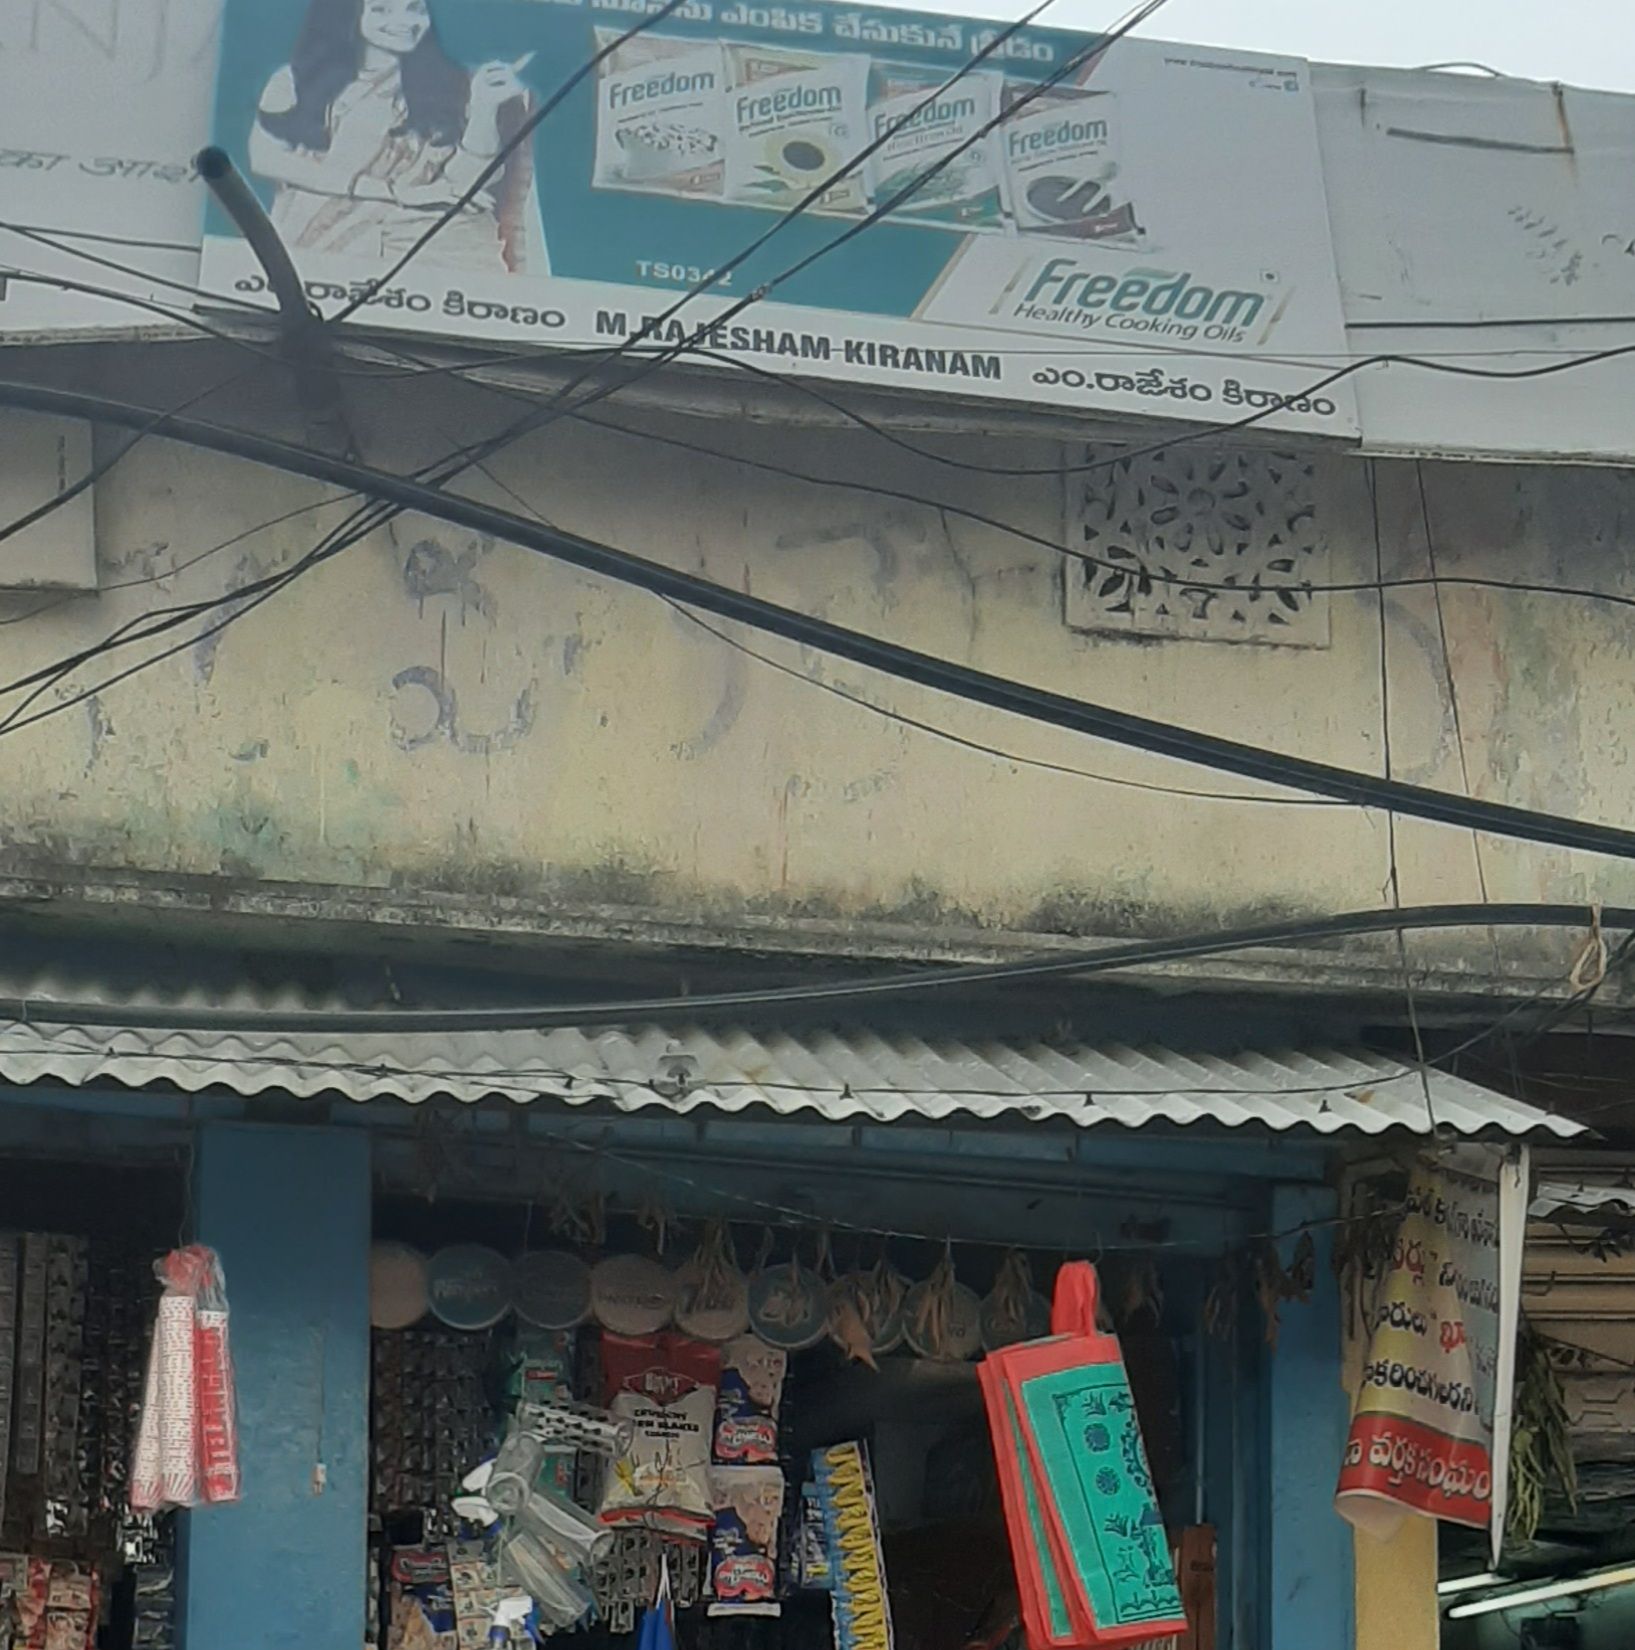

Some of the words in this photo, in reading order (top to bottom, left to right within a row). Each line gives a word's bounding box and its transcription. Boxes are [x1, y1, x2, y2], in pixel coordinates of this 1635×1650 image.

[609, 71, 715, 110] Freedom
[735, 84, 842, 124] Freedom
[874, 97, 975, 141] Freedom
[1008, 118, 1108, 158] Freedom
[1023, 257, 1265, 328] Freedom
[1013, 302, 1102, 330] Healthy
[1104, 313, 1198, 341] Cooking
[1202, 323, 1247, 344] Oils
[844, 339, 1002, 380] KIRANAM
